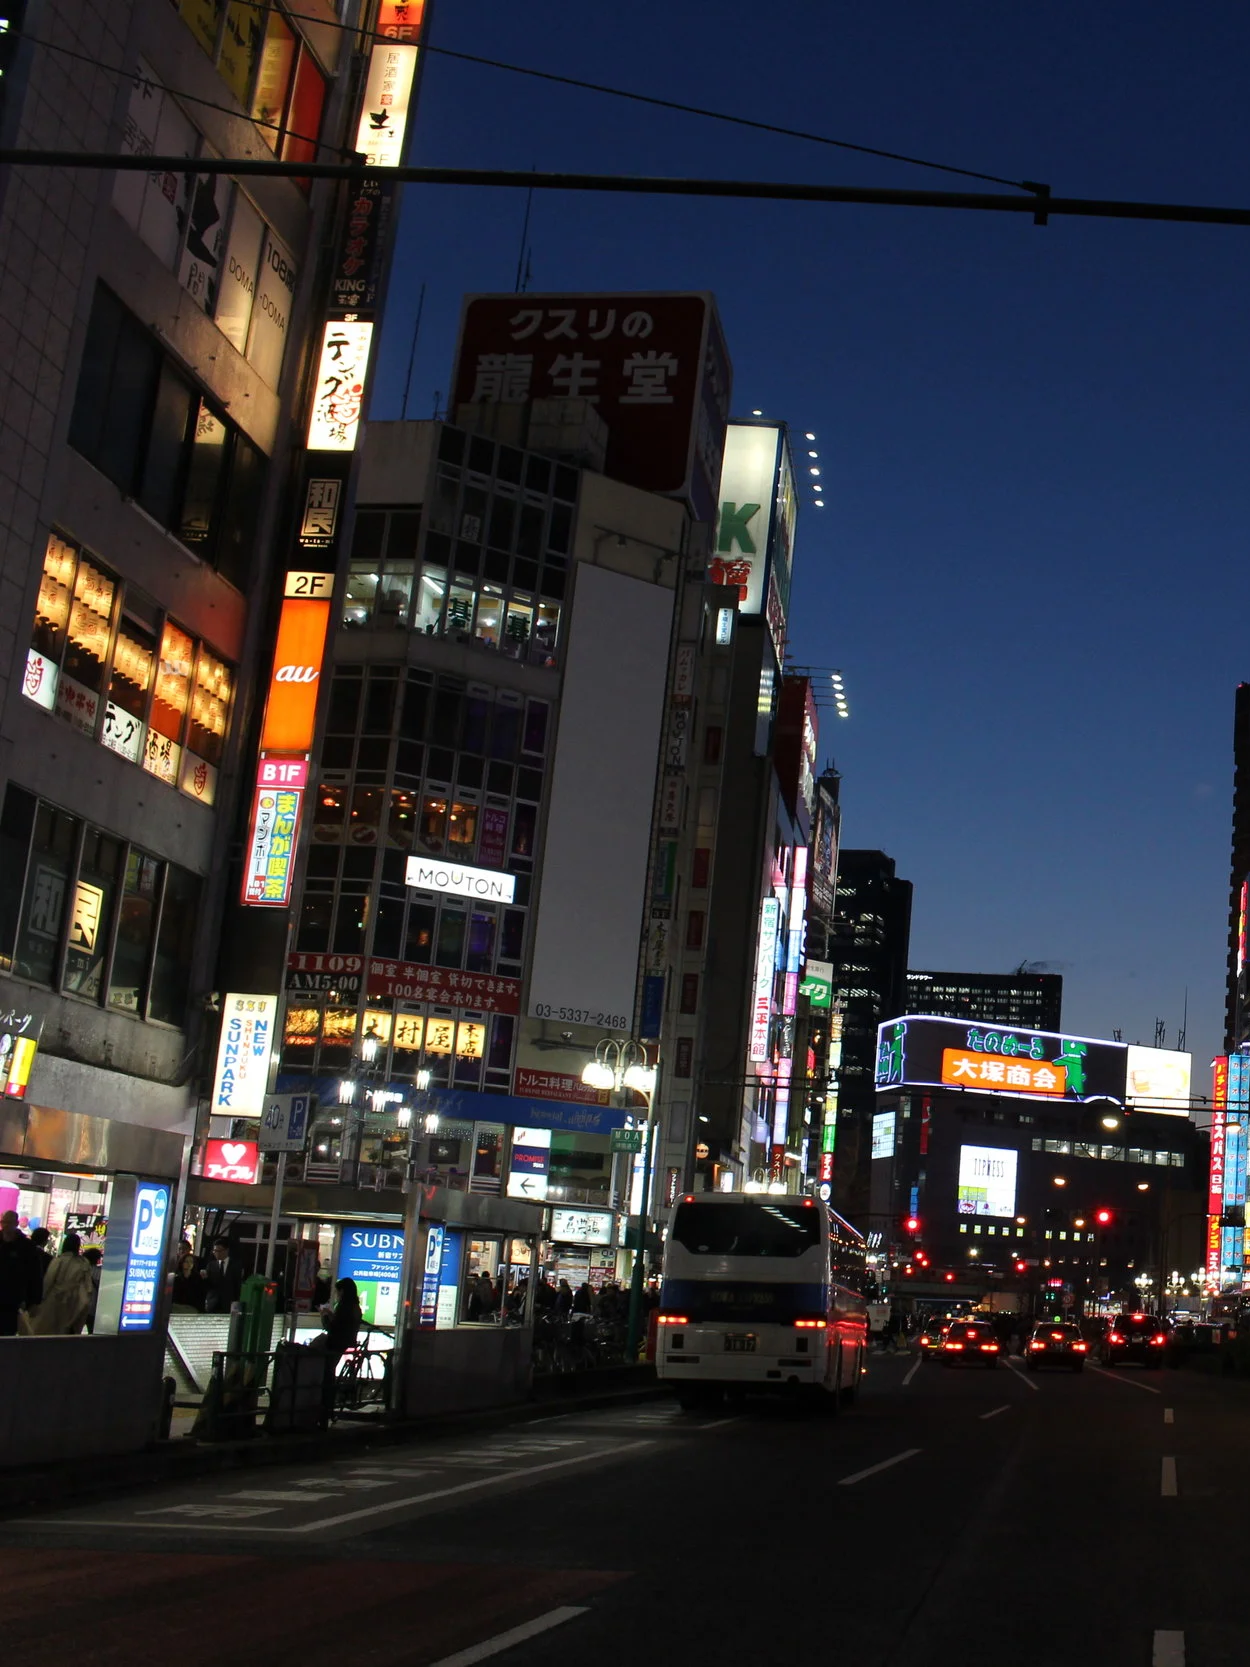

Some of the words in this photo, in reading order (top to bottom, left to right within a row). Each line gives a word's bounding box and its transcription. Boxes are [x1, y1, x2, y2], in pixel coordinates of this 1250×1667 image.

[384, 26, 413, 40] 6F
[342, 197, 374, 276] カラオケ
[229, 256, 253, 293] DOMA
[335, 279, 366, 292] KING
[344, 314, 358, 322] 3F
[509, 309, 655, 341] クスリの
[470, 348, 680, 405] 龍生堂
[305, 483, 338, 535] 和民
[718, 501, 761, 554] K
[294, 576, 325, 594] 2F
[275, 664, 320, 684] au
[671, 711, 686, 764] MOUTON
[262, 765, 301, 781] B1F
[254, 812, 271, 874] マンボー
[265, 794, 297, 900] まんが喫茶
[417, 866, 502, 898] MOUTON
[758, 903, 776, 989] 新宿サンパーク
[288, 974, 358, 992] AM5:00
[371, 961, 398, 978] 個室
[402, 967, 444, 986] 半個室
[448, 972, 520, 998] 貸切できます。
[800, 982, 828, 1001] イク
[386, 982, 508, 1012] 100名宴会承ります。
[535, 1003, 627, 1030] 03-5337-2468
[751, 997, 769, 1056] 三平本館
[238, 1020, 253, 1081] SHINJUKU
[252, 1021, 269, 1057] NEW
[967, 1027, 1045, 1059] たのめーる
[218, 1019, 243, 1108] SUNPARK
[952, 1057, 1057, 1089] 大塚商会
[519, 1071, 573, 1092] トルコ料理
[1215, 1063, 1226, 1108] パチンコ
[293, 1100, 304, 1124] P
[208, 1164, 254, 1182] アイフル
[515, 1153, 545, 1163] PROMISE
[135, 1198, 153, 1249] P
[129, 1267, 156, 1279] SUBNADE
[371, 1263, 400, 1272] ファッション
